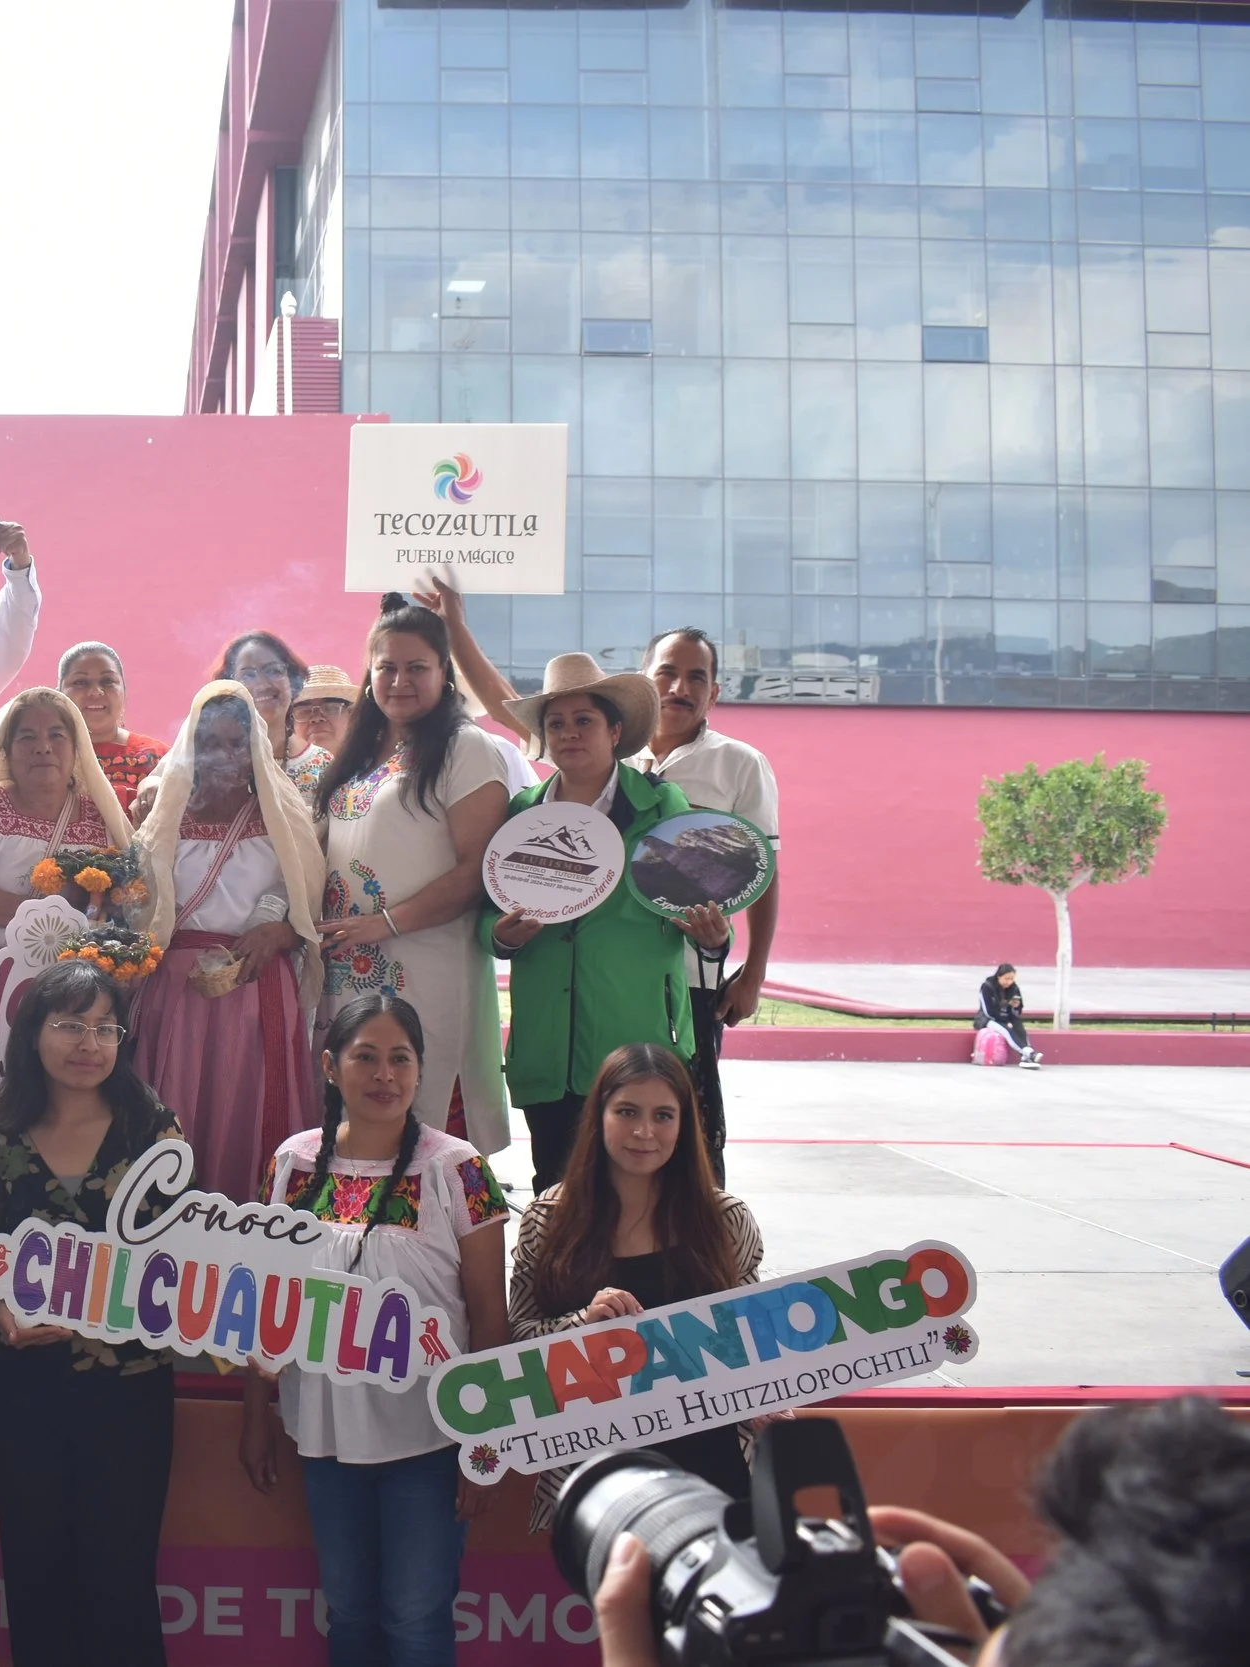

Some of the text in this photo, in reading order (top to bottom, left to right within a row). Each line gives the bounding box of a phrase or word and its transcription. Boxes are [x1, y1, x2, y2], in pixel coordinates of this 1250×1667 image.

[521, 854, 583, 872] TURISMO
[732, 820, 769, 870] Comunitarias
[486, 849, 511, 904] Experiencias
[561, 868, 616, 917] Comunitarias
[554, 870, 596, 883] TUTOTEPEC
[117, 1149, 322, 1246] Conoce
[436, 1248, 969, 1435] CHAPANTONGO
[636, 1407, 670, 1438] DE
[157, 1584, 243, 1638] DE
